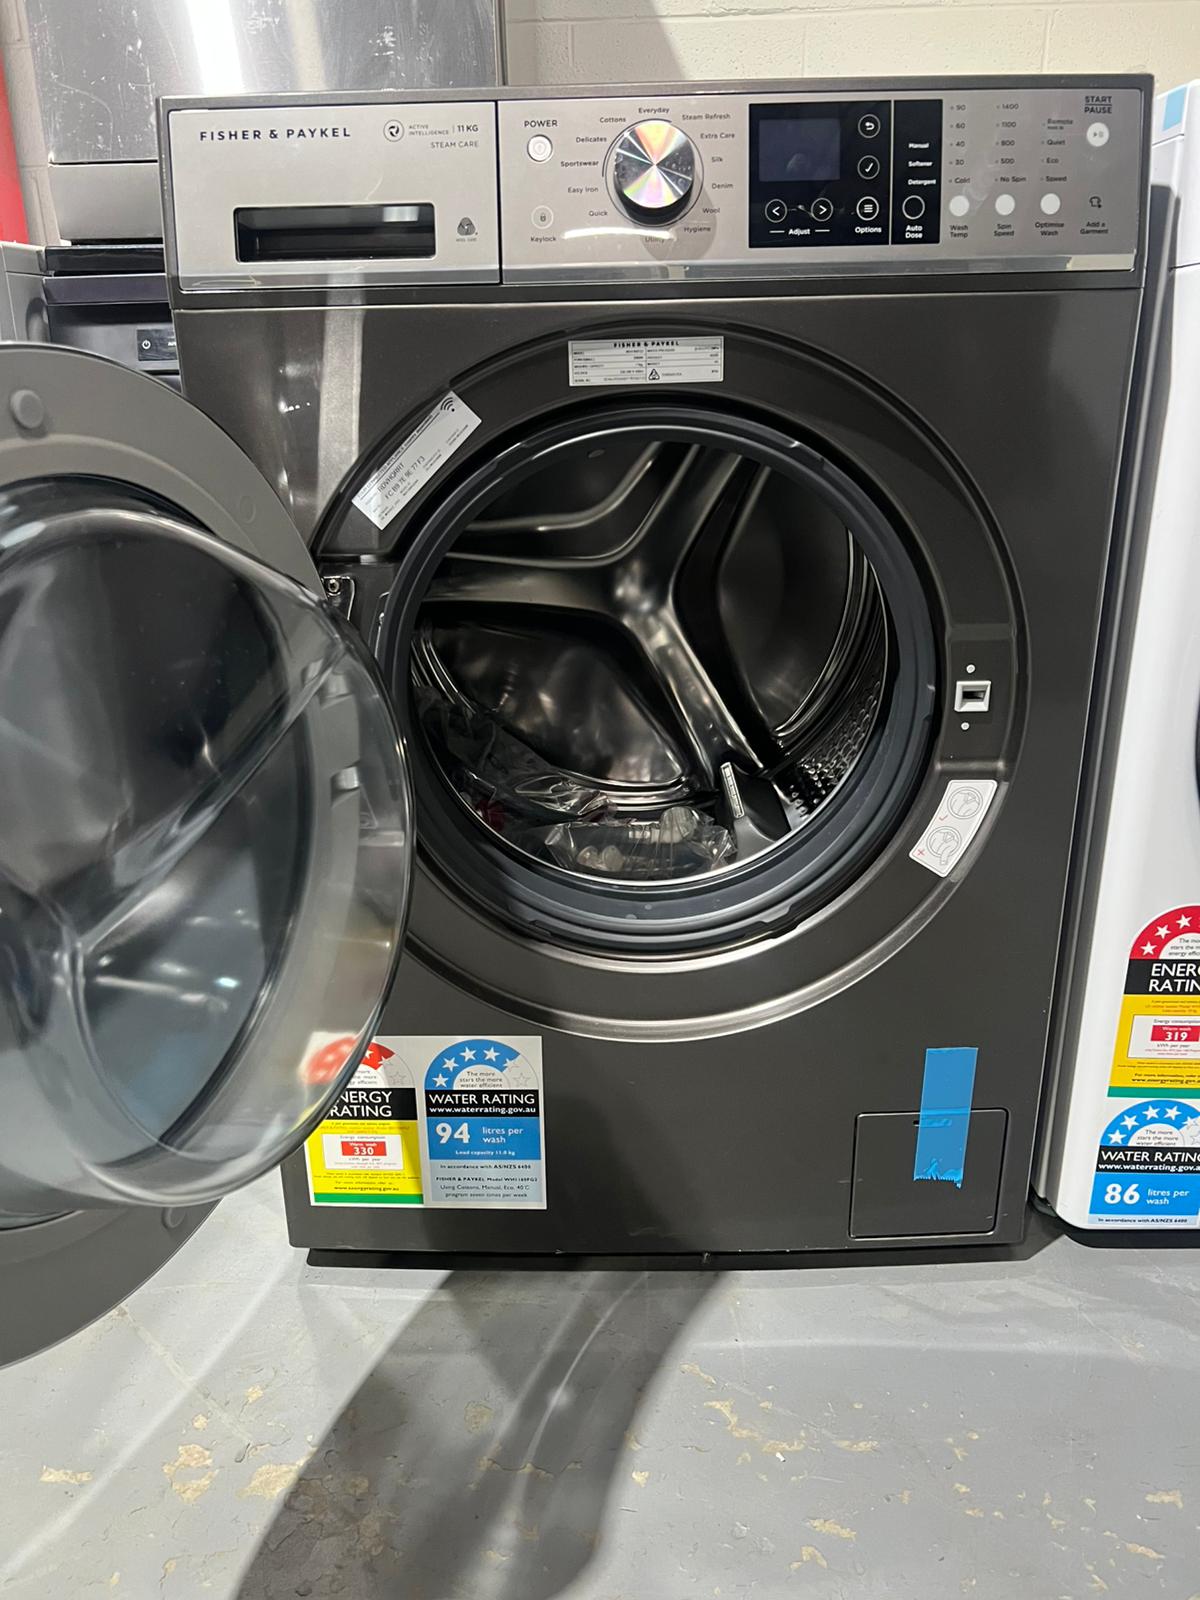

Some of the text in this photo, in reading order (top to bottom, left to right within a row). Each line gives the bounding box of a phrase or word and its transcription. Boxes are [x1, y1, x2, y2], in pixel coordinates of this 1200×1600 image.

[466, 124, 479, 132] KG
[524, 120, 558, 128] POWER
[200, 127, 351, 141] FISHER & PAYKEL
[431, 141, 456, 149] STEAM
[560, 160, 599, 168] Sportswear
[908, 178, 937, 186] Detergent
[567, 186, 583, 194] Easy
[788, 228, 811, 236] Adjust
[854, 226, 882, 234] Options
[950, 231, 969, 239] Temp
[1151, 963, 1200, 977] ENER
[1164, 1031, 1188, 1041] 319
[340, 1091, 392, 1104] NERGY
[428, 1094, 535, 1104] WATER RATING
[330, 1105, 392, 1117] RATING
[429, 1106, 536, 1114] www.waterrating.gov.au
[435, 1122, 471, 1144] 94
[482, 1126, 524, 1137] litres per
[482, 1136, 506, 1144] wash
[353, 1147, 374, 1156] 330
[1100, 1151, 1150, 1162] WATER
[1104, 1183, 1140, 1205] 86
[1147, 1188, 1190, 1198] litres per
